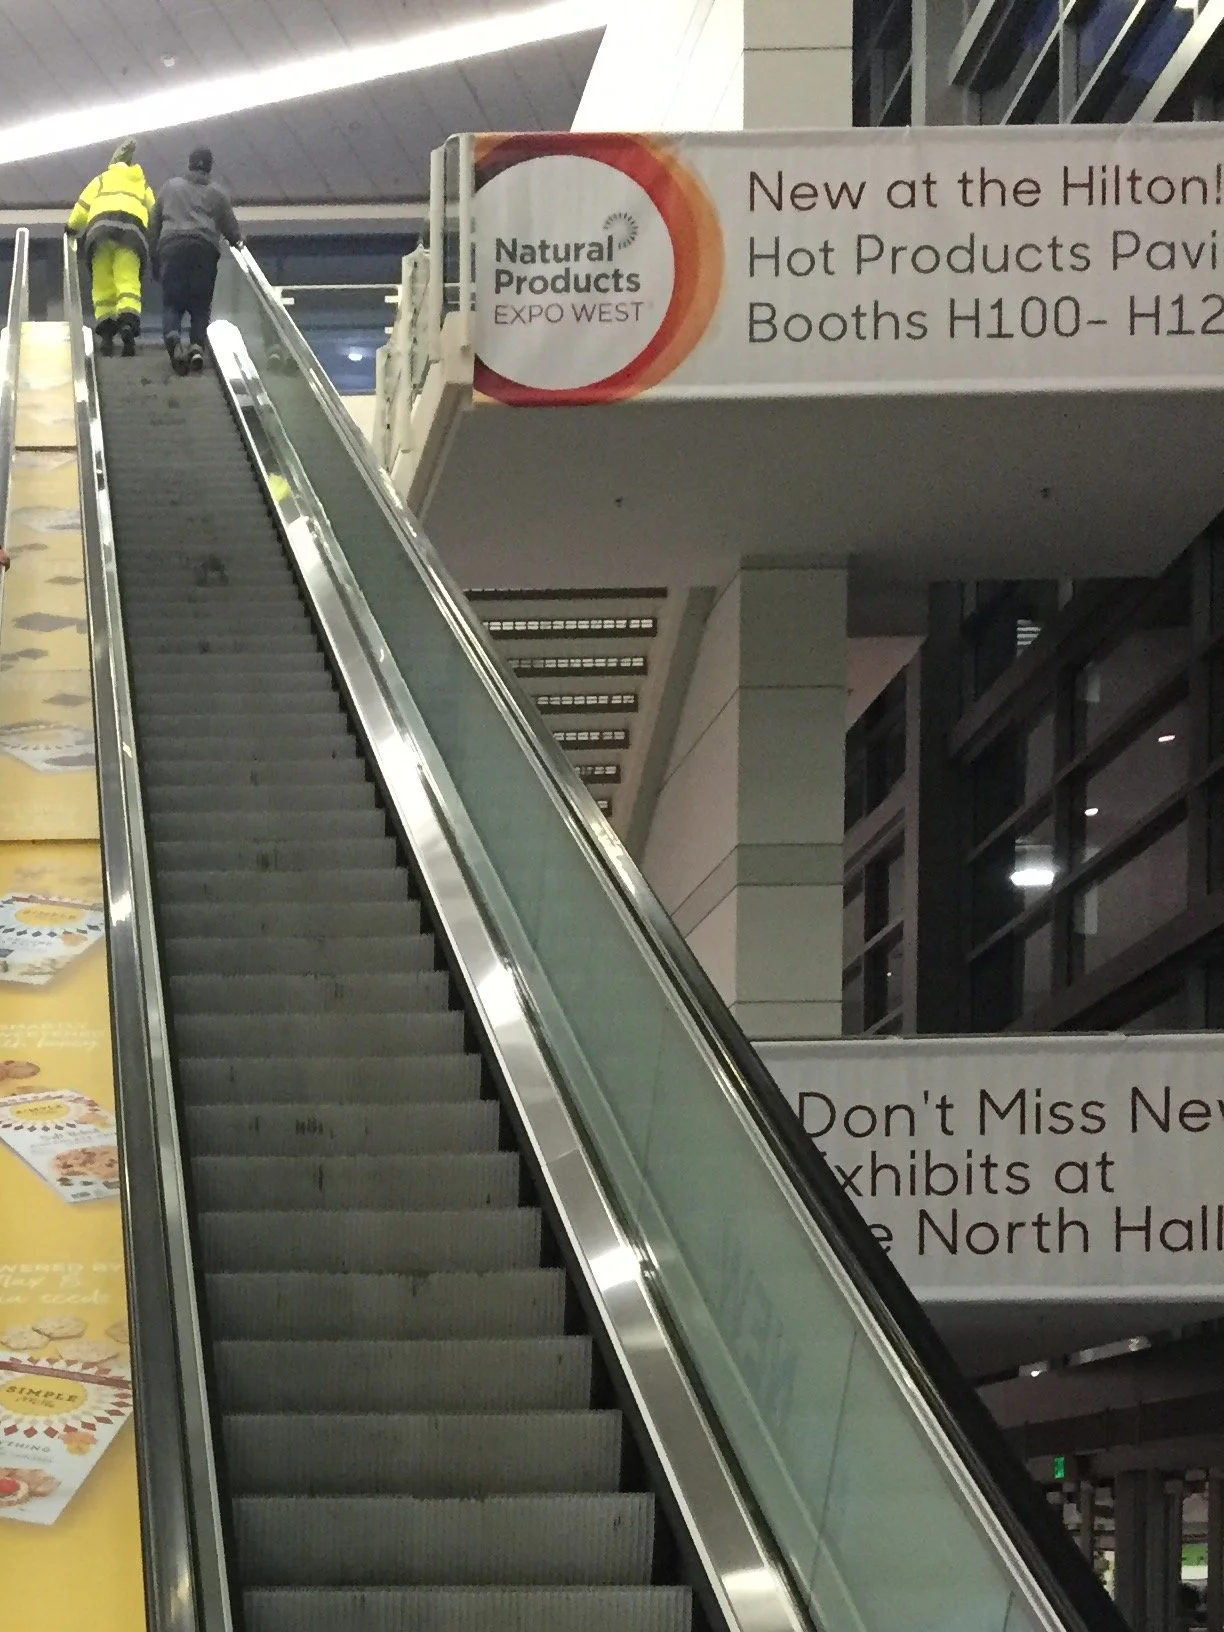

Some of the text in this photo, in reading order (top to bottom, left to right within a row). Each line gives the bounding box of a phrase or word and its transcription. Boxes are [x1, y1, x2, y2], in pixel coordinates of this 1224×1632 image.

[748, 163, 1223, 212] New at the Hilton!
[494, 234, 614, 265] Natural
[748, 236, 836, 278] Hot
[856, 230, 1092, 276] Products
[494, 266, 642, 296] Products
[494, 301, 645, 325] EXPO WEST
[748, 298, 928, 344] Booths
[949, 295, 1108, 339] H100-
[797, 1090, 955, 1138] Don't
[978, 1087, 1107, 1136] Miss
[820, 1148, 1117, 1198] xhibits at
[918, 1206, 1090, 1256] North
[1115, 1204, 1224, 1252] Hall
[6, 1385, 79, 1402] SIMPLE
